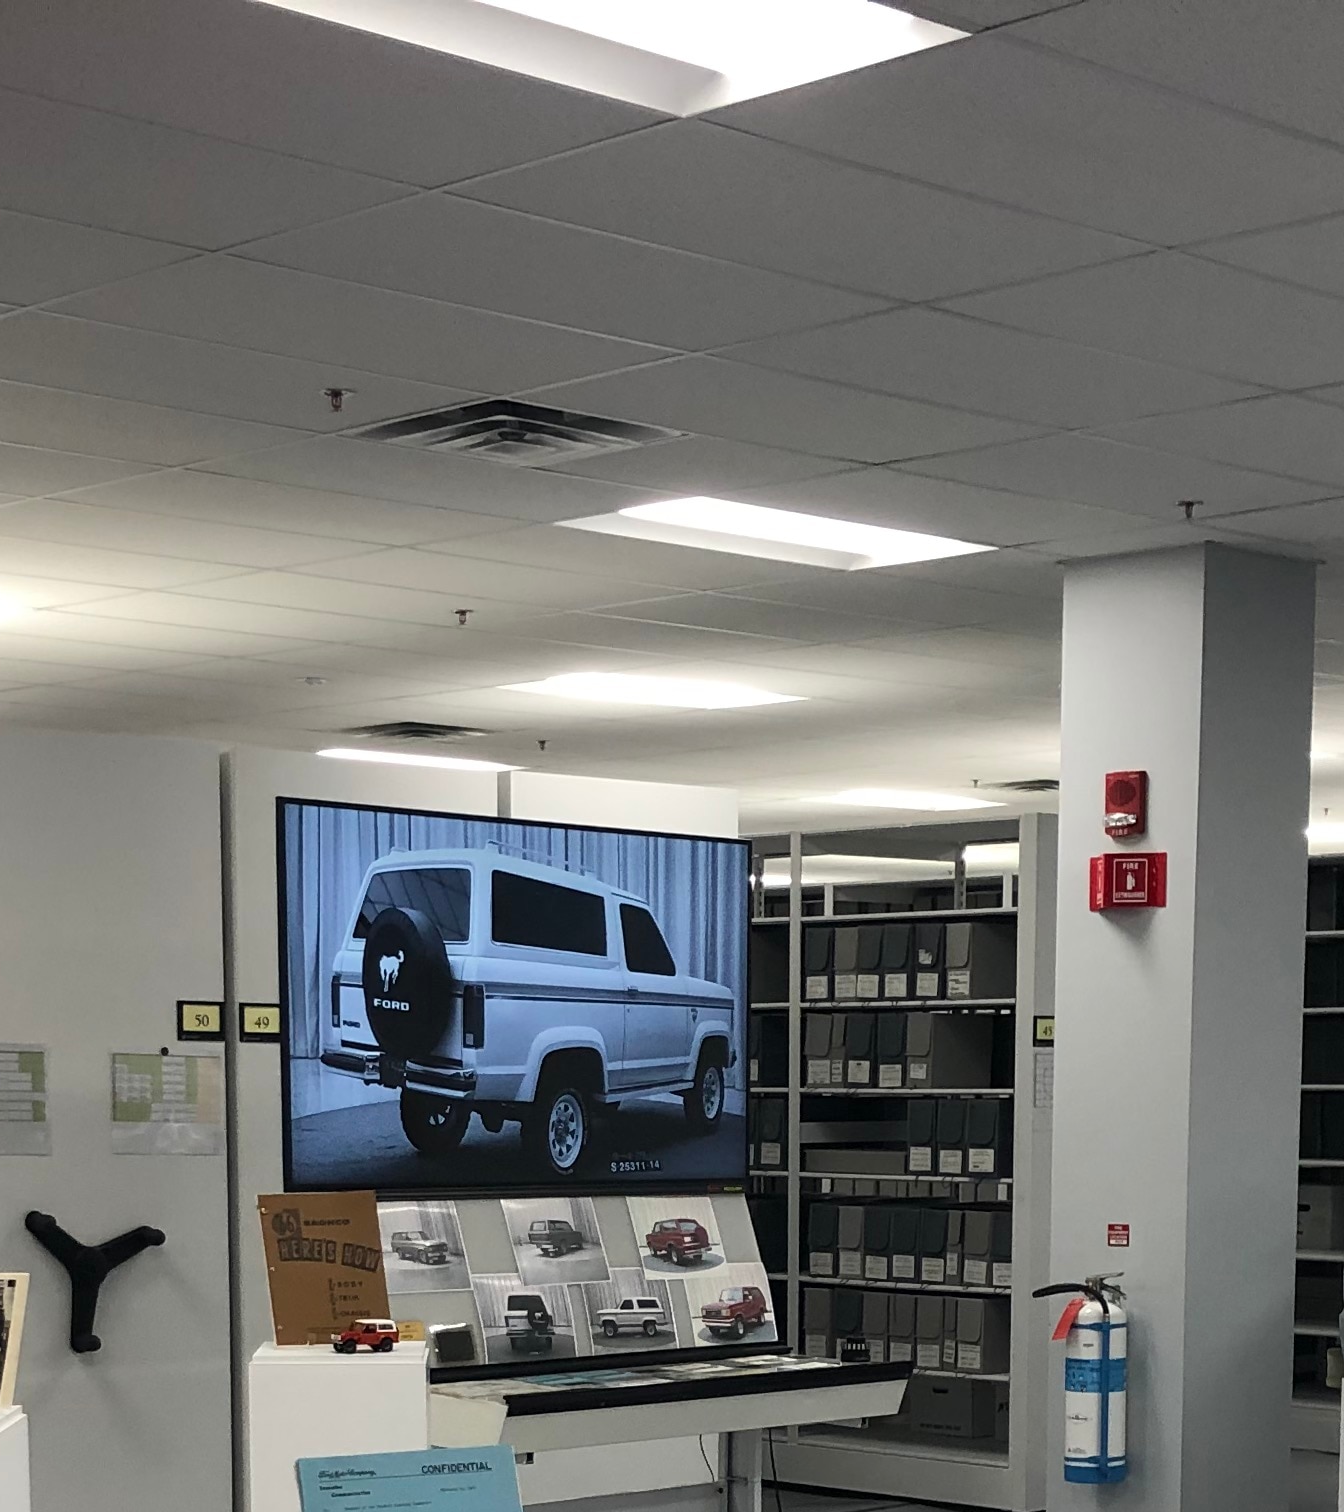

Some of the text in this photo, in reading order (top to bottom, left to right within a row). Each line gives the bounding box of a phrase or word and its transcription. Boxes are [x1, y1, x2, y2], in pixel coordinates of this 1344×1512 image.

[1122, 862, 1139, 870] FIRE
[373, 998, 410, 1011] FORD
[194, 1014, 209, 1027] 50
[254, 1016, 270, 1029] 49
[279, 1238, 381, 1272] HERE'S HOW
[421, 1462, 492, 1475] CONFIDENTIAL
